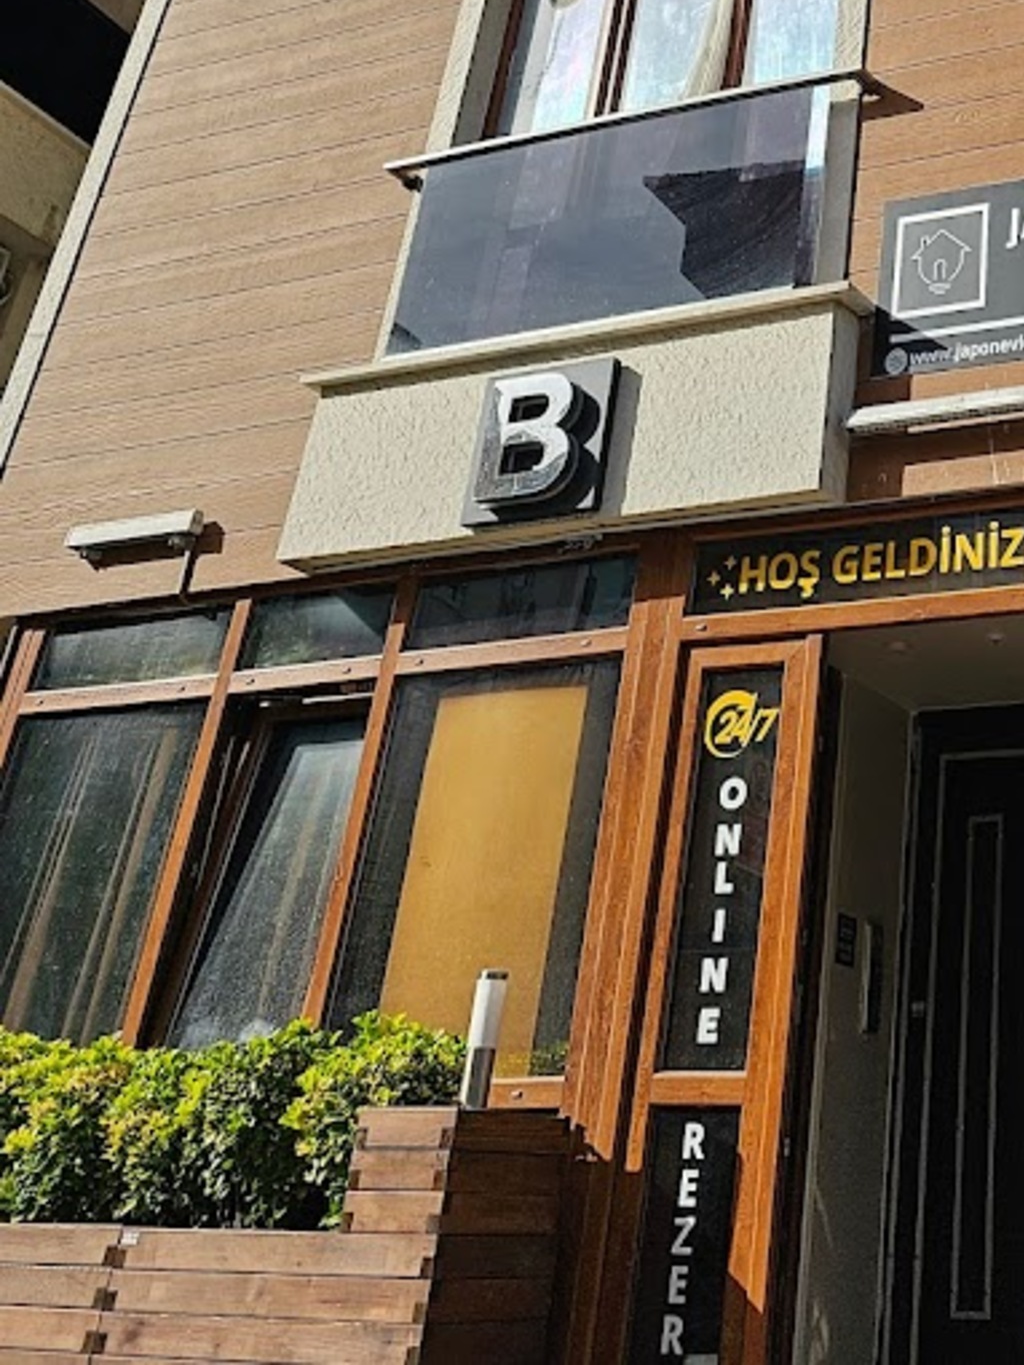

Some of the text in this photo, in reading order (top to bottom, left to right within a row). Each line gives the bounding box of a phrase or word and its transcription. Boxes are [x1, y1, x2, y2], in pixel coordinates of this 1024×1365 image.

[473, 372, 575, 504] B
[738, 550, 820, 598] HOŞ
[713, 692, 780, 747] 24/7
[696, 776, 748, 1045] ONLINE
